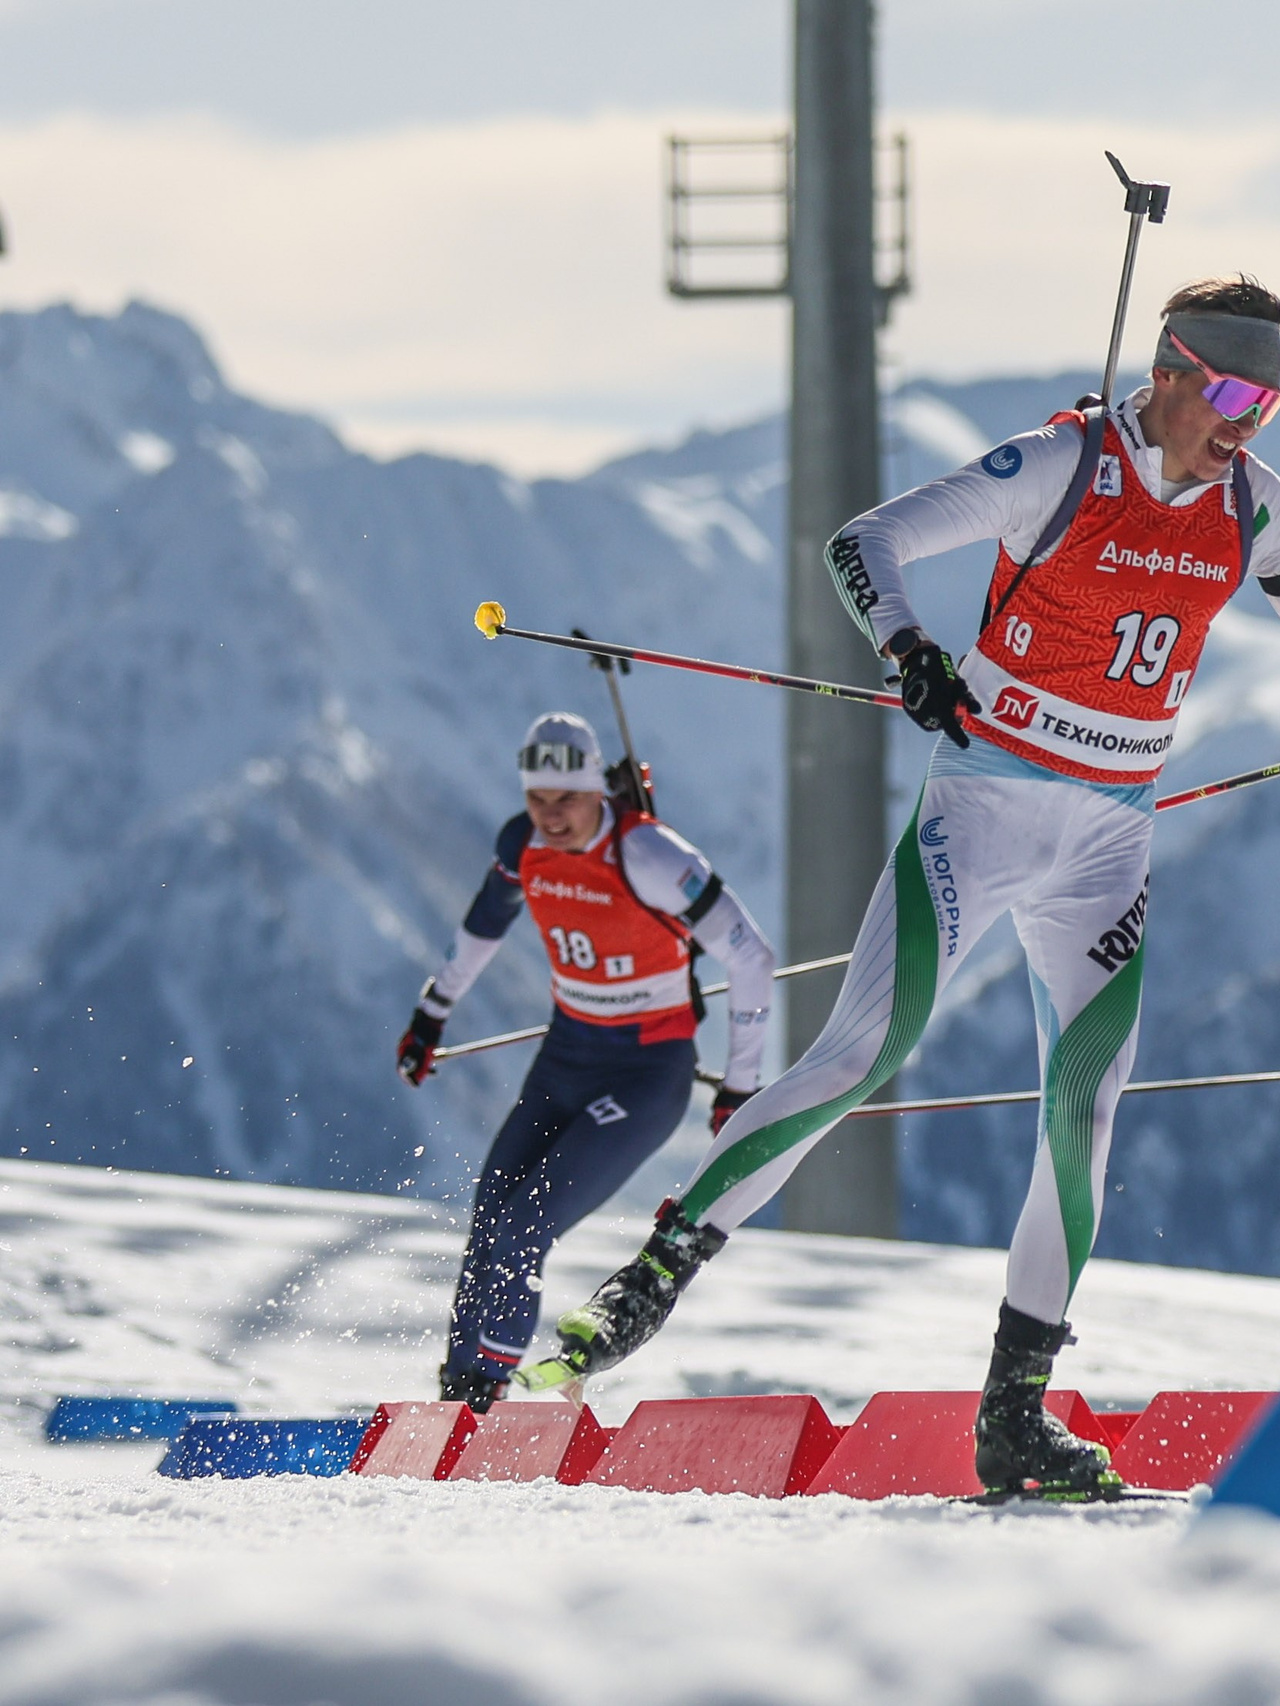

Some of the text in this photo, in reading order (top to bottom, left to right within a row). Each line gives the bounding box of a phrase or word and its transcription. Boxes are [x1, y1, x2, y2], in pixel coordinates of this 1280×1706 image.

[1096, 540, 1229, 583] Альфа Банк
[1004, 615, 1033, 657] 19
[1105, 611, 1181, 688] 19
[1173, 677, 1184, 703] 1
[923, 857, 945, 931] СТРАХОВАНИЕ
[932, 852, 960, 957] ЮГОРИЯ
[549, 925, 597, 971] 18
